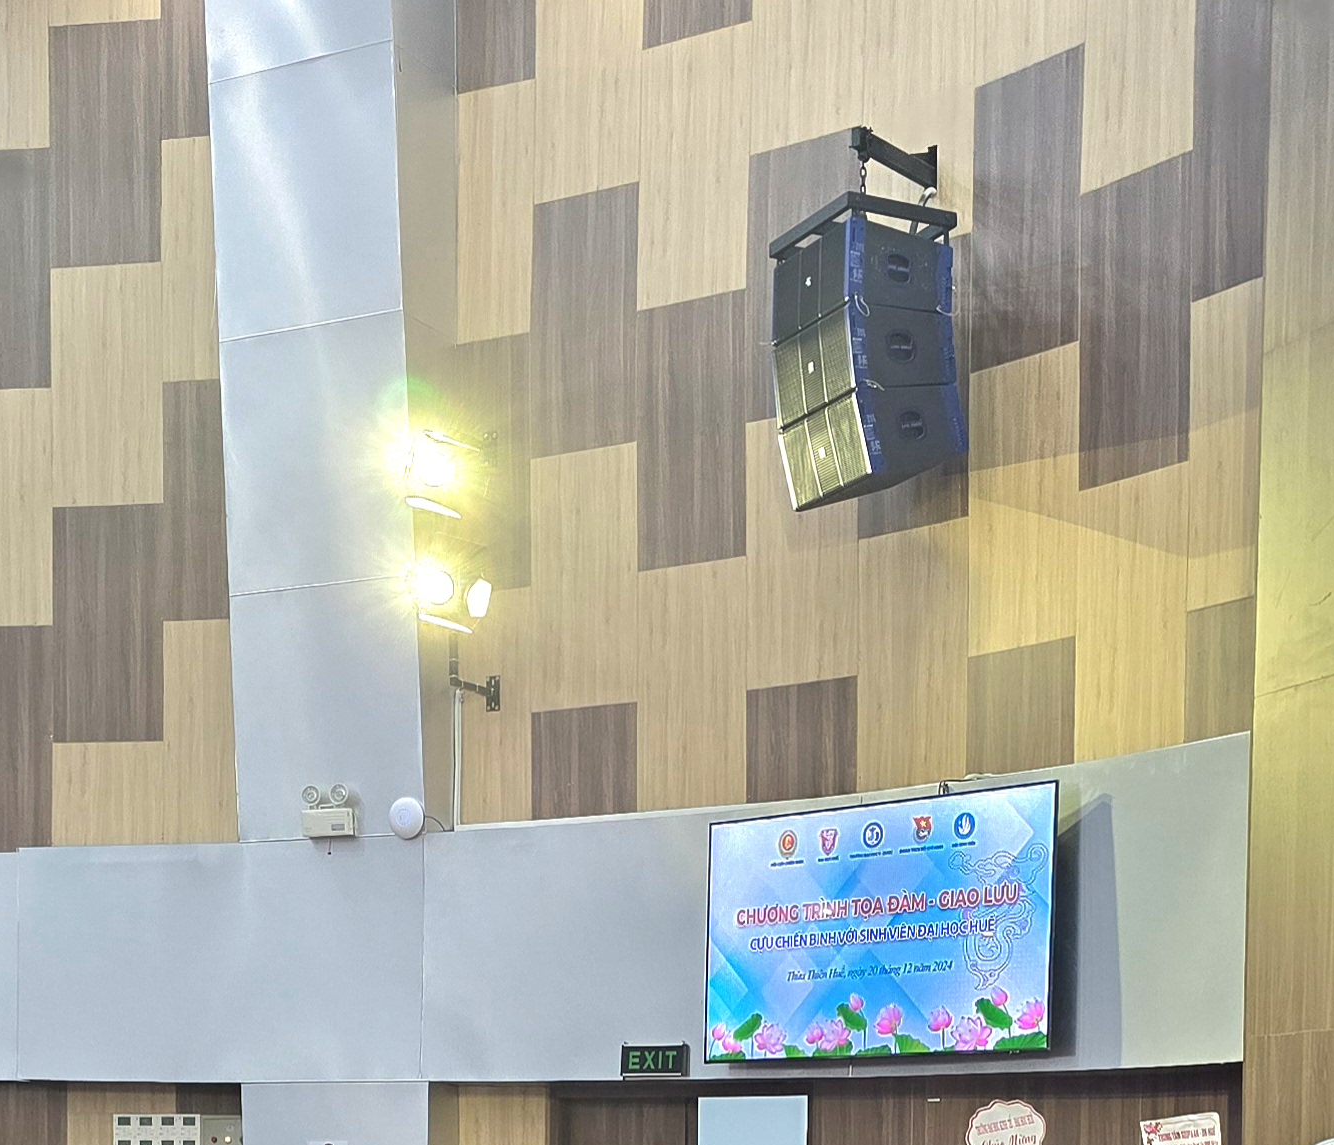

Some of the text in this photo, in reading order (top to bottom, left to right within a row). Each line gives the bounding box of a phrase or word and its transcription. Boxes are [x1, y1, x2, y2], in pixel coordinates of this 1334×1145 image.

[736, 903, 799, 927] CHƯƠNG
[802, 898, 848, 921] TRÌNH
[851, 897, 885, 921] TỌA
[888, 890, 926, 914] ĐÀM
[939, 888, 980, 910] GIAO
[983, 880, 1019, 905] LƯU
[750, 914, 996, 955] CỰU CHIẾN BINH VỚI SINH VIÊN ĐẠI HỌC HUẾ
[629, 1050, 677, 1070] EXIT
